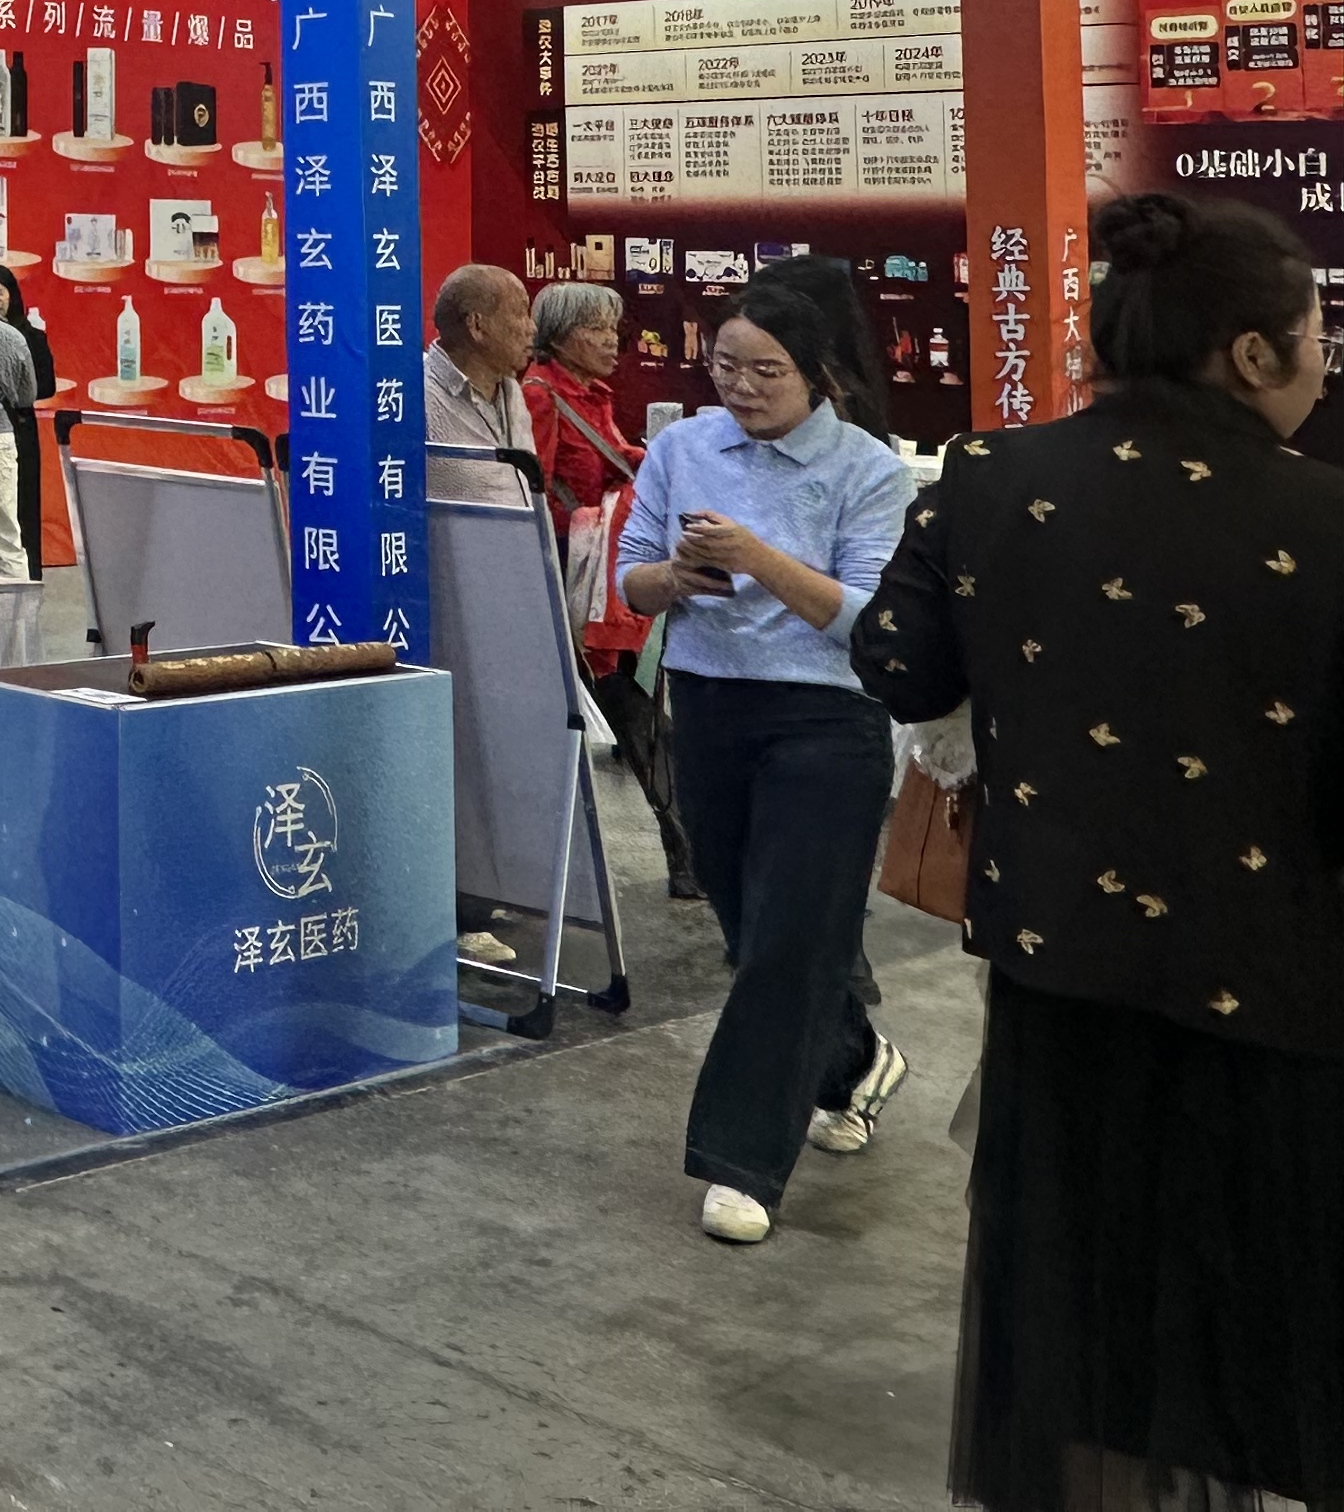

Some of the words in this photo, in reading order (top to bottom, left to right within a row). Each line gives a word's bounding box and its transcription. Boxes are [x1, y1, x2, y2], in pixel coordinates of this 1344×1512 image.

[1175, 147, 1327, 180] 0基础小白
[1299, 182, 1344, 214] 成
[367, 4, 410, 651] 广西泽玄医药有限公
[990, 225, 1034, 429] 经典古方传
[264, 782, 333, 898] 泽玄
[232, 907, 360, 974] 泽玄医药
